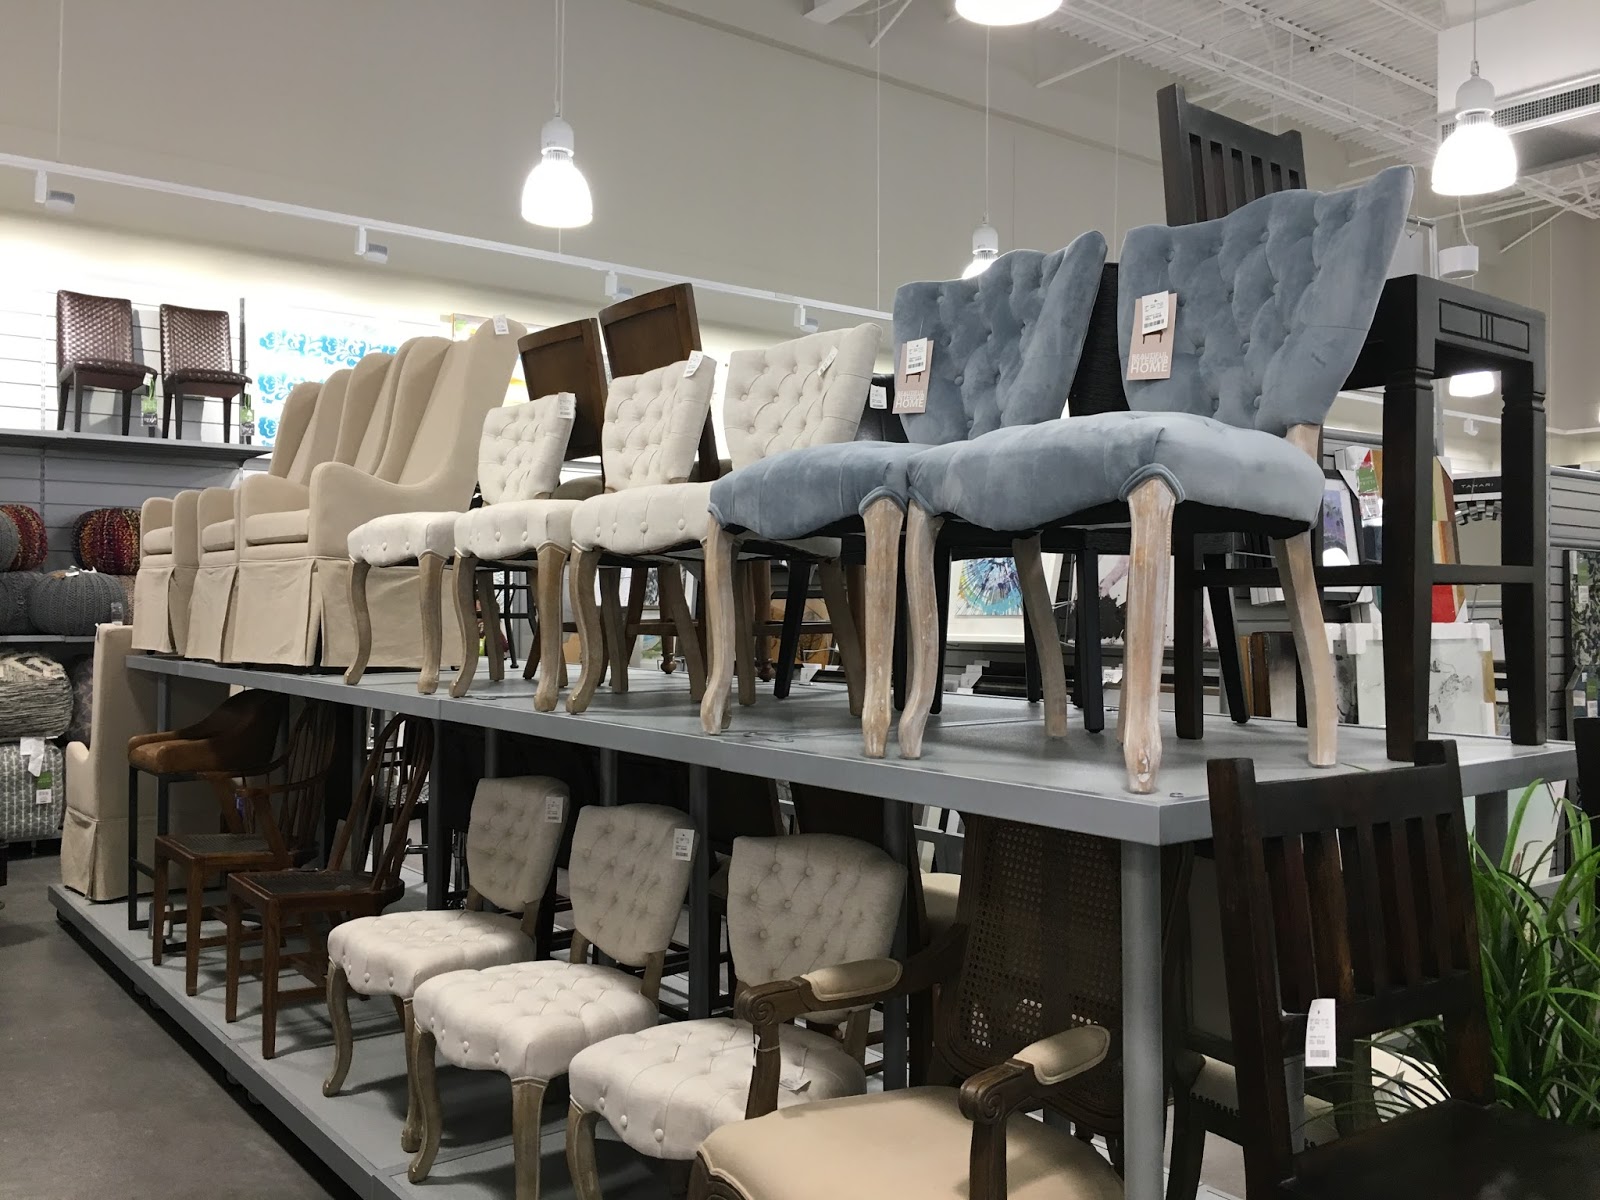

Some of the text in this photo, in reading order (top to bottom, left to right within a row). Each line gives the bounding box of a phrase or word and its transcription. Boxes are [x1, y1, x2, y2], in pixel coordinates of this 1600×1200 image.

[1132, 352, 1168, 360] BEAUTIFUL
[1130, 362, 1169, 374] HOME
[895, 399, 924, 409] HOME
